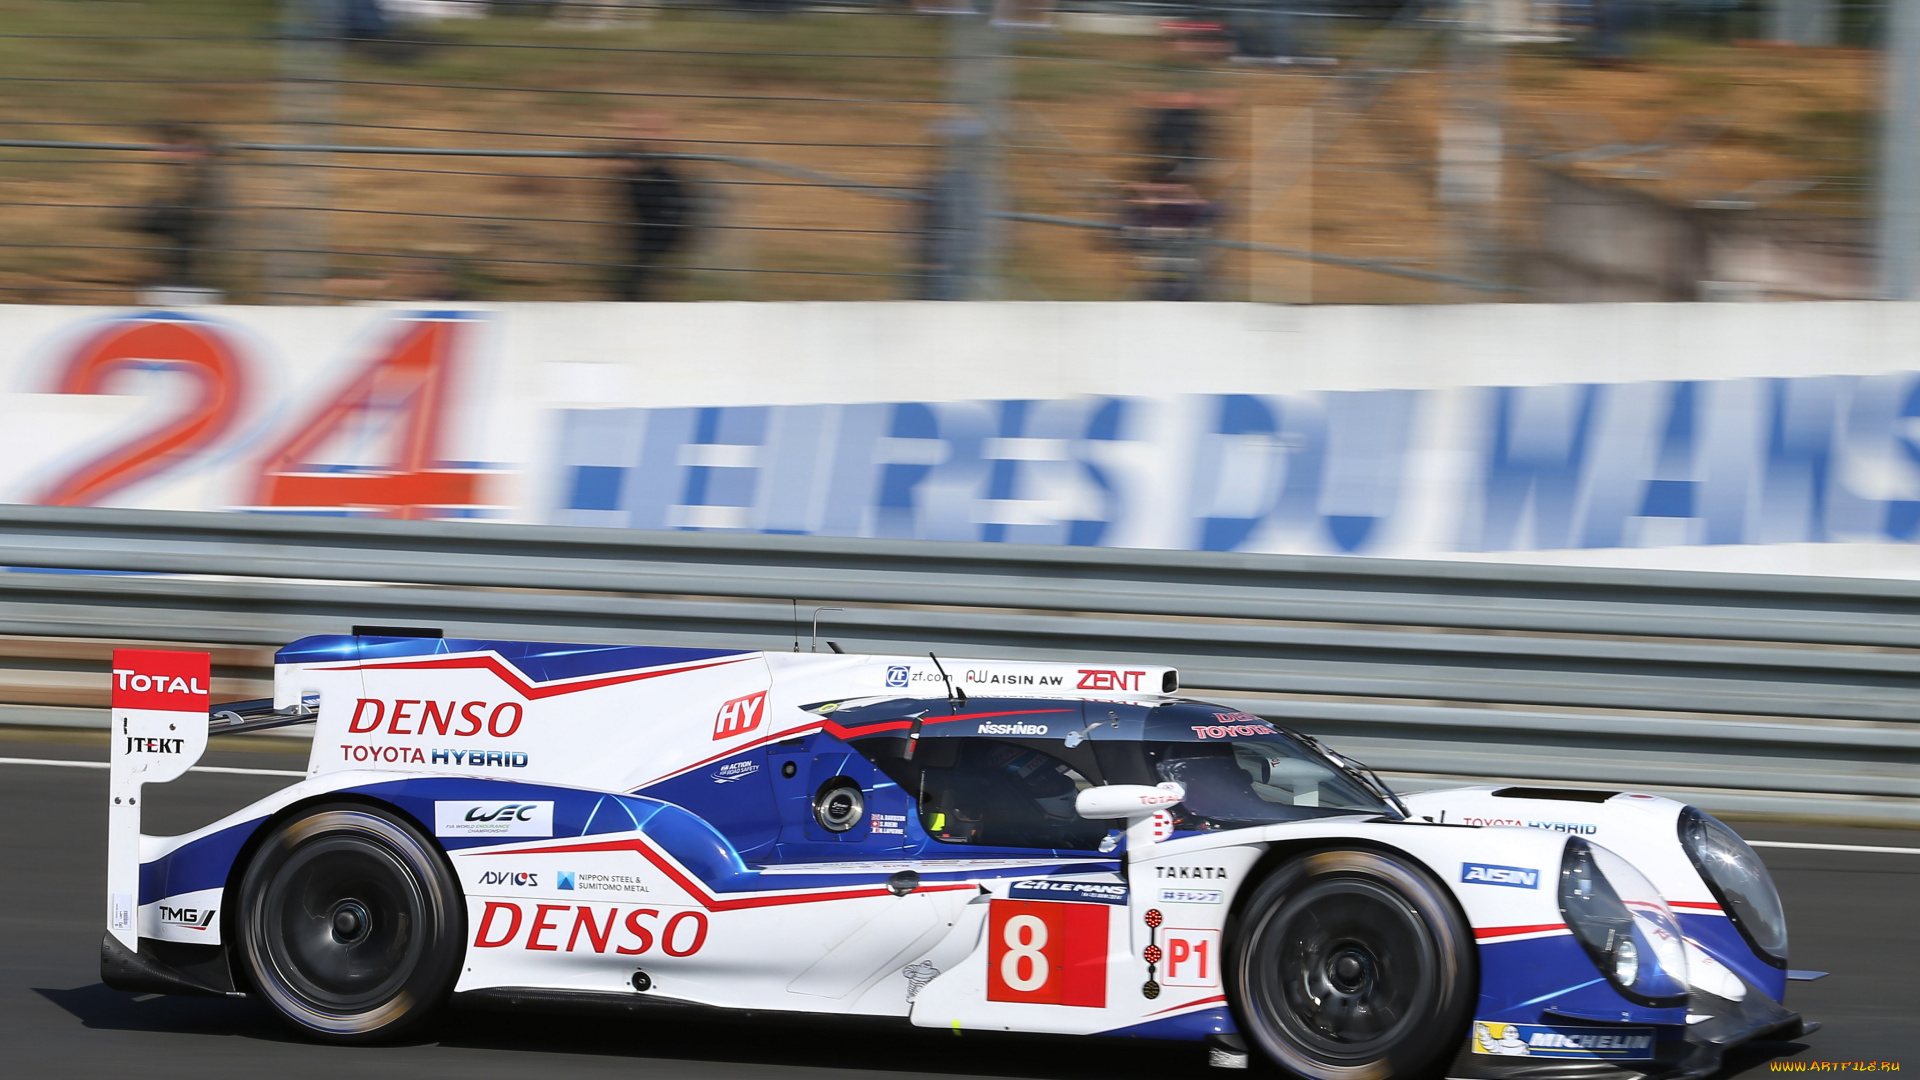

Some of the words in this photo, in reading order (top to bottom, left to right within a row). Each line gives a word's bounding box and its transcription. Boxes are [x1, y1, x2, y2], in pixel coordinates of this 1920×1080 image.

[38, 310, 498, 518] 24
[112, 668, 208, 695] TOTAL
[912, 672, 953, 683] zf.com
[991, 674, 1034, 685] AISIN
[1039, 675, 1063, 685] AW
[1077, 669, 1146, 691] ZENT
[348, 698, 523, 738] DENSO
[715, 696, 764, 734] HY
[1191, 725, 1277, 739] TOYOTA
[125, 737, 184, 755] JTEKT
[340, 745, 426, 763] TOYOTA
[431, 748, 529, 768] HYBRID
[729, 760, 753, 770] ACTION
[1139, 795, 1183, 805] TOTAL
[464, 804, 537, 822] WEC
[1528, 820, 1597, 834] HYBRID
[478, 871, 538, 887] ADVICS
[579, 873, 609, 884] NIPPON
[611, 875, 634, 884] STEEL
[635, 876, 642, 884] &
[1156, 866, 1228, 879] TAKATA
[1465, 866, 1537, 885] AISIN
[579, 883, 622, 892] SUMITOMO
[624, 884, 650, 893] METAL
[1050, 883, 1073, 891] LE
[1074, 885, 1127, 895] MANS
[159, 906, 198, 923] TMG
[474, 902, 708, 957] DENSO
[1001, 914, 1049, 992] 8
[1168, 938, 1209, 979] P1
[1529, 1032, 1652, 1049] MICHELIN
